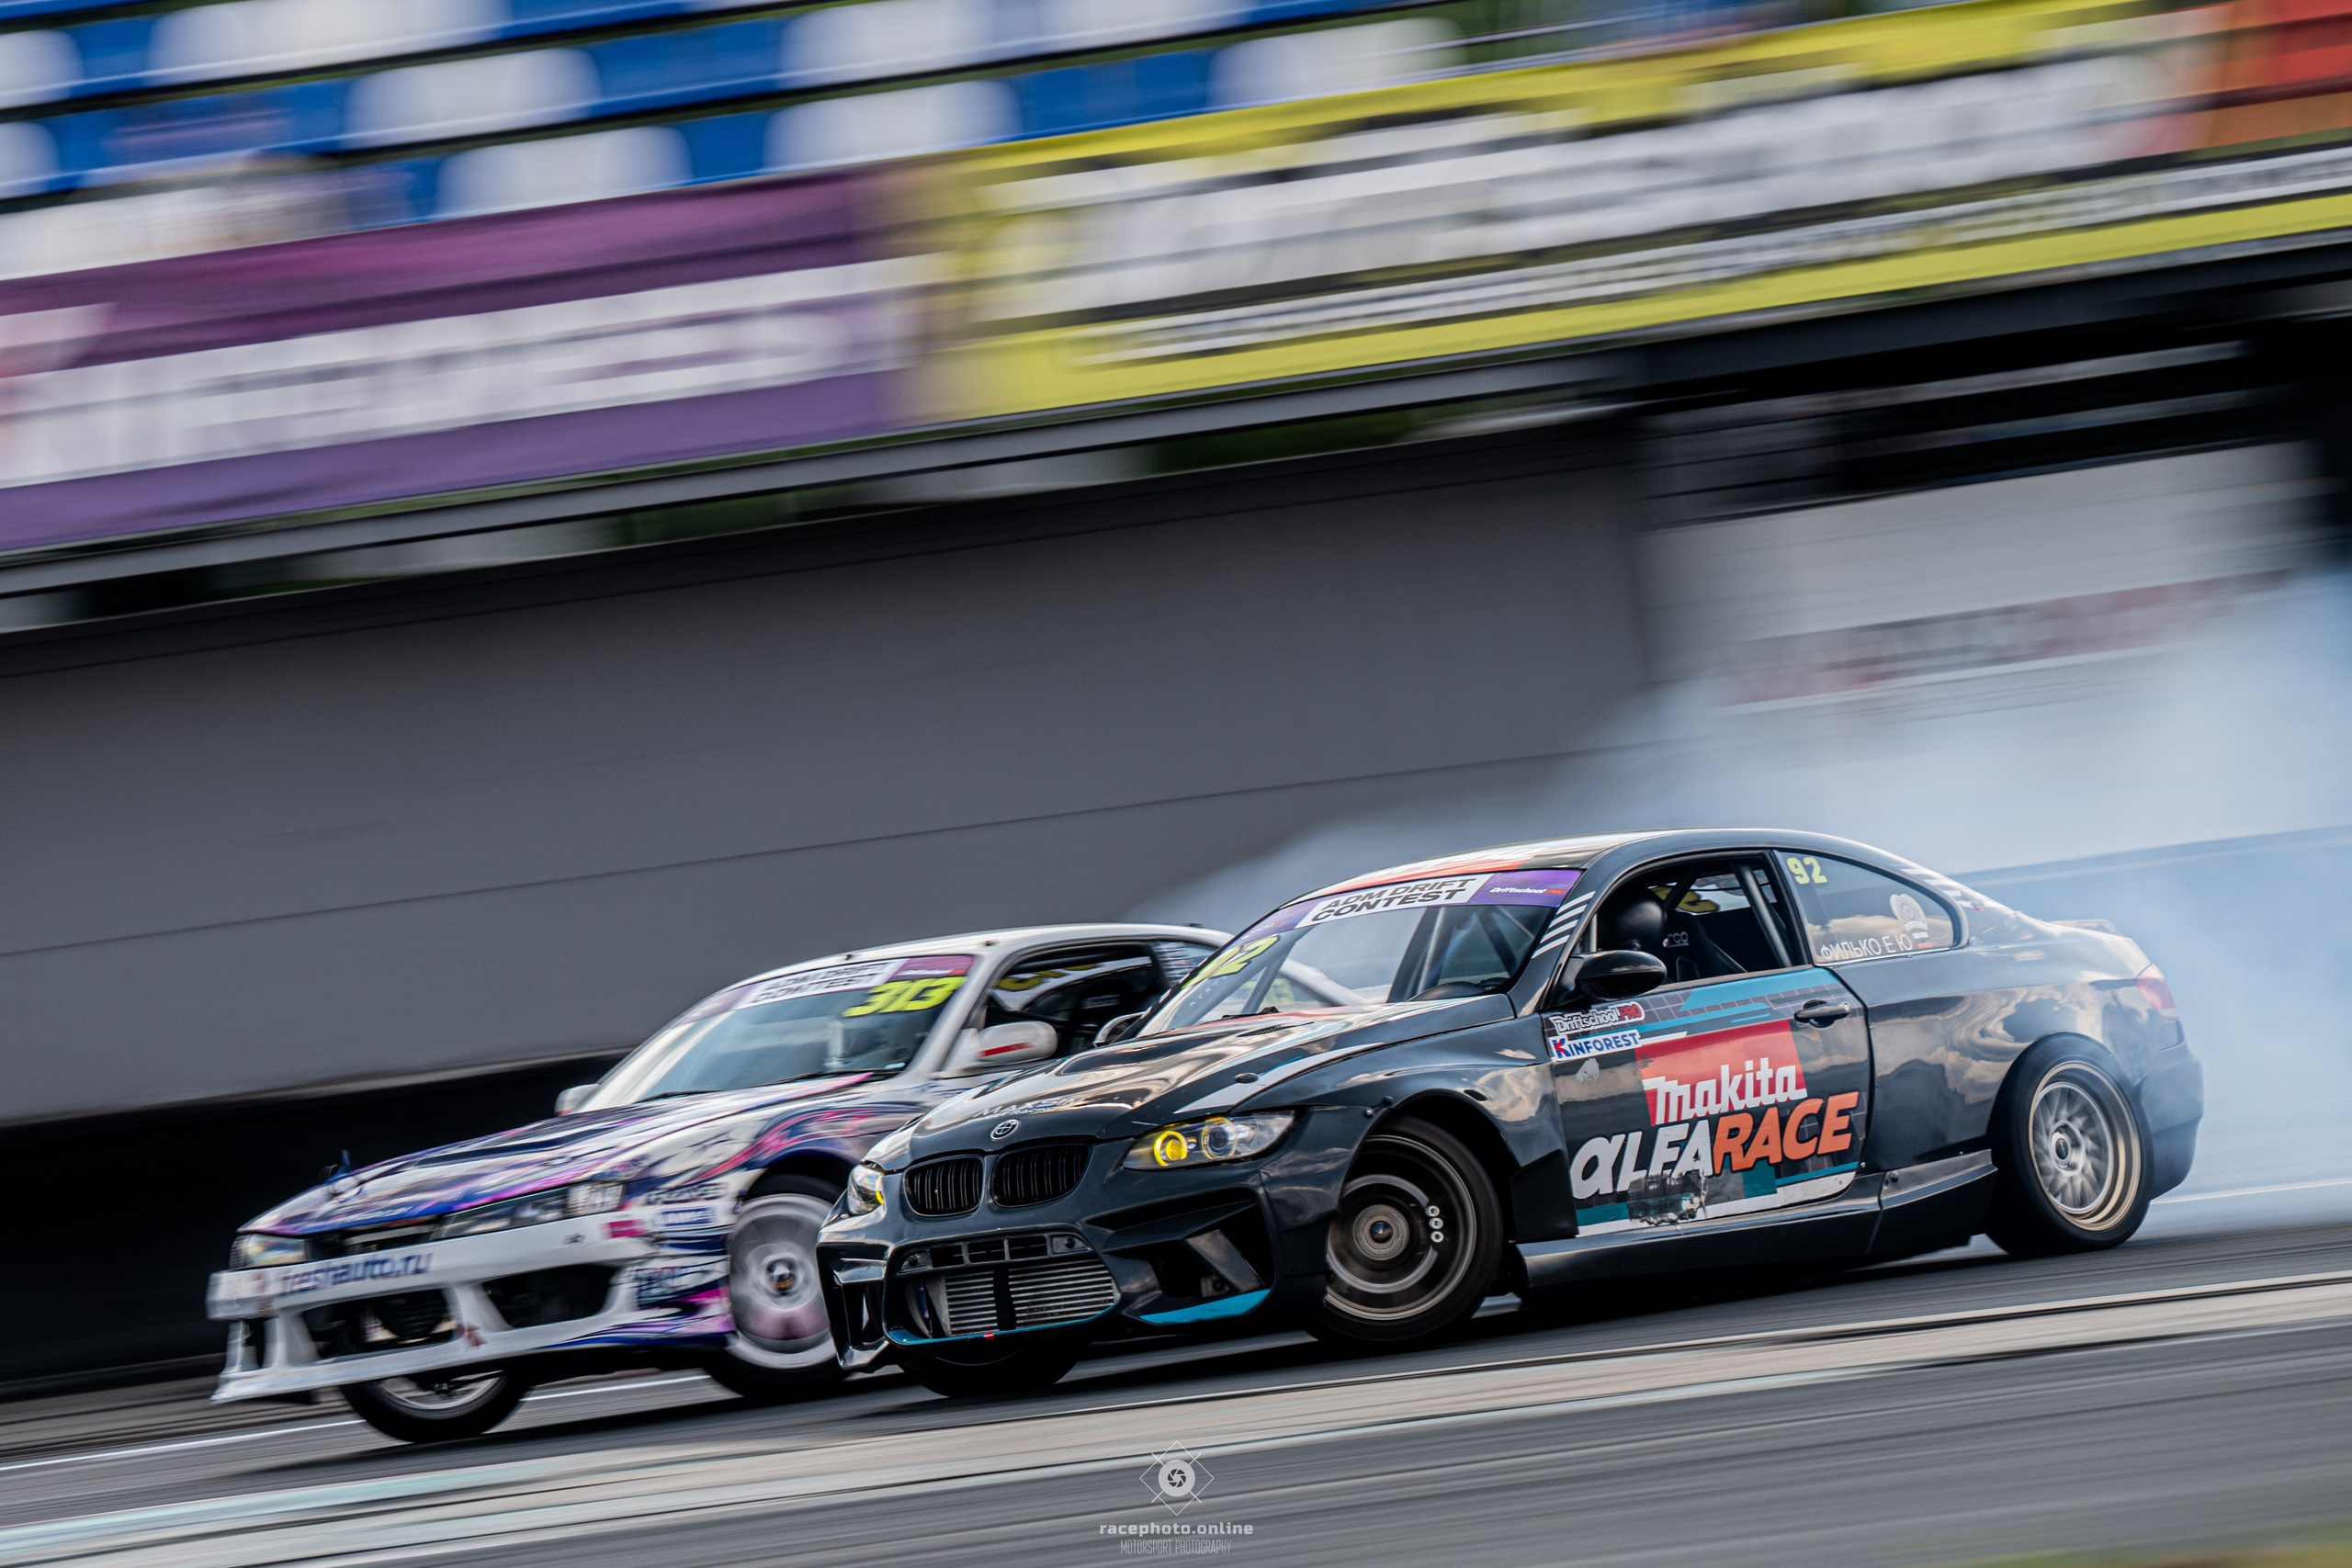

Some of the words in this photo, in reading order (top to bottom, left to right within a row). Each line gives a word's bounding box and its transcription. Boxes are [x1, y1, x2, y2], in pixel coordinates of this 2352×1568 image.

[1786, 856, 1828, 885] 92
[1312, 888, 1466, 921] CONTEST
[1320, 889, 1387, 909] ADM
[1388, 877, 1477, 897] DRIFT
[1820, 937, 1882, 961] ФИЛЬКО
[1552, 1032, 1639, 1059] KINFOREST
